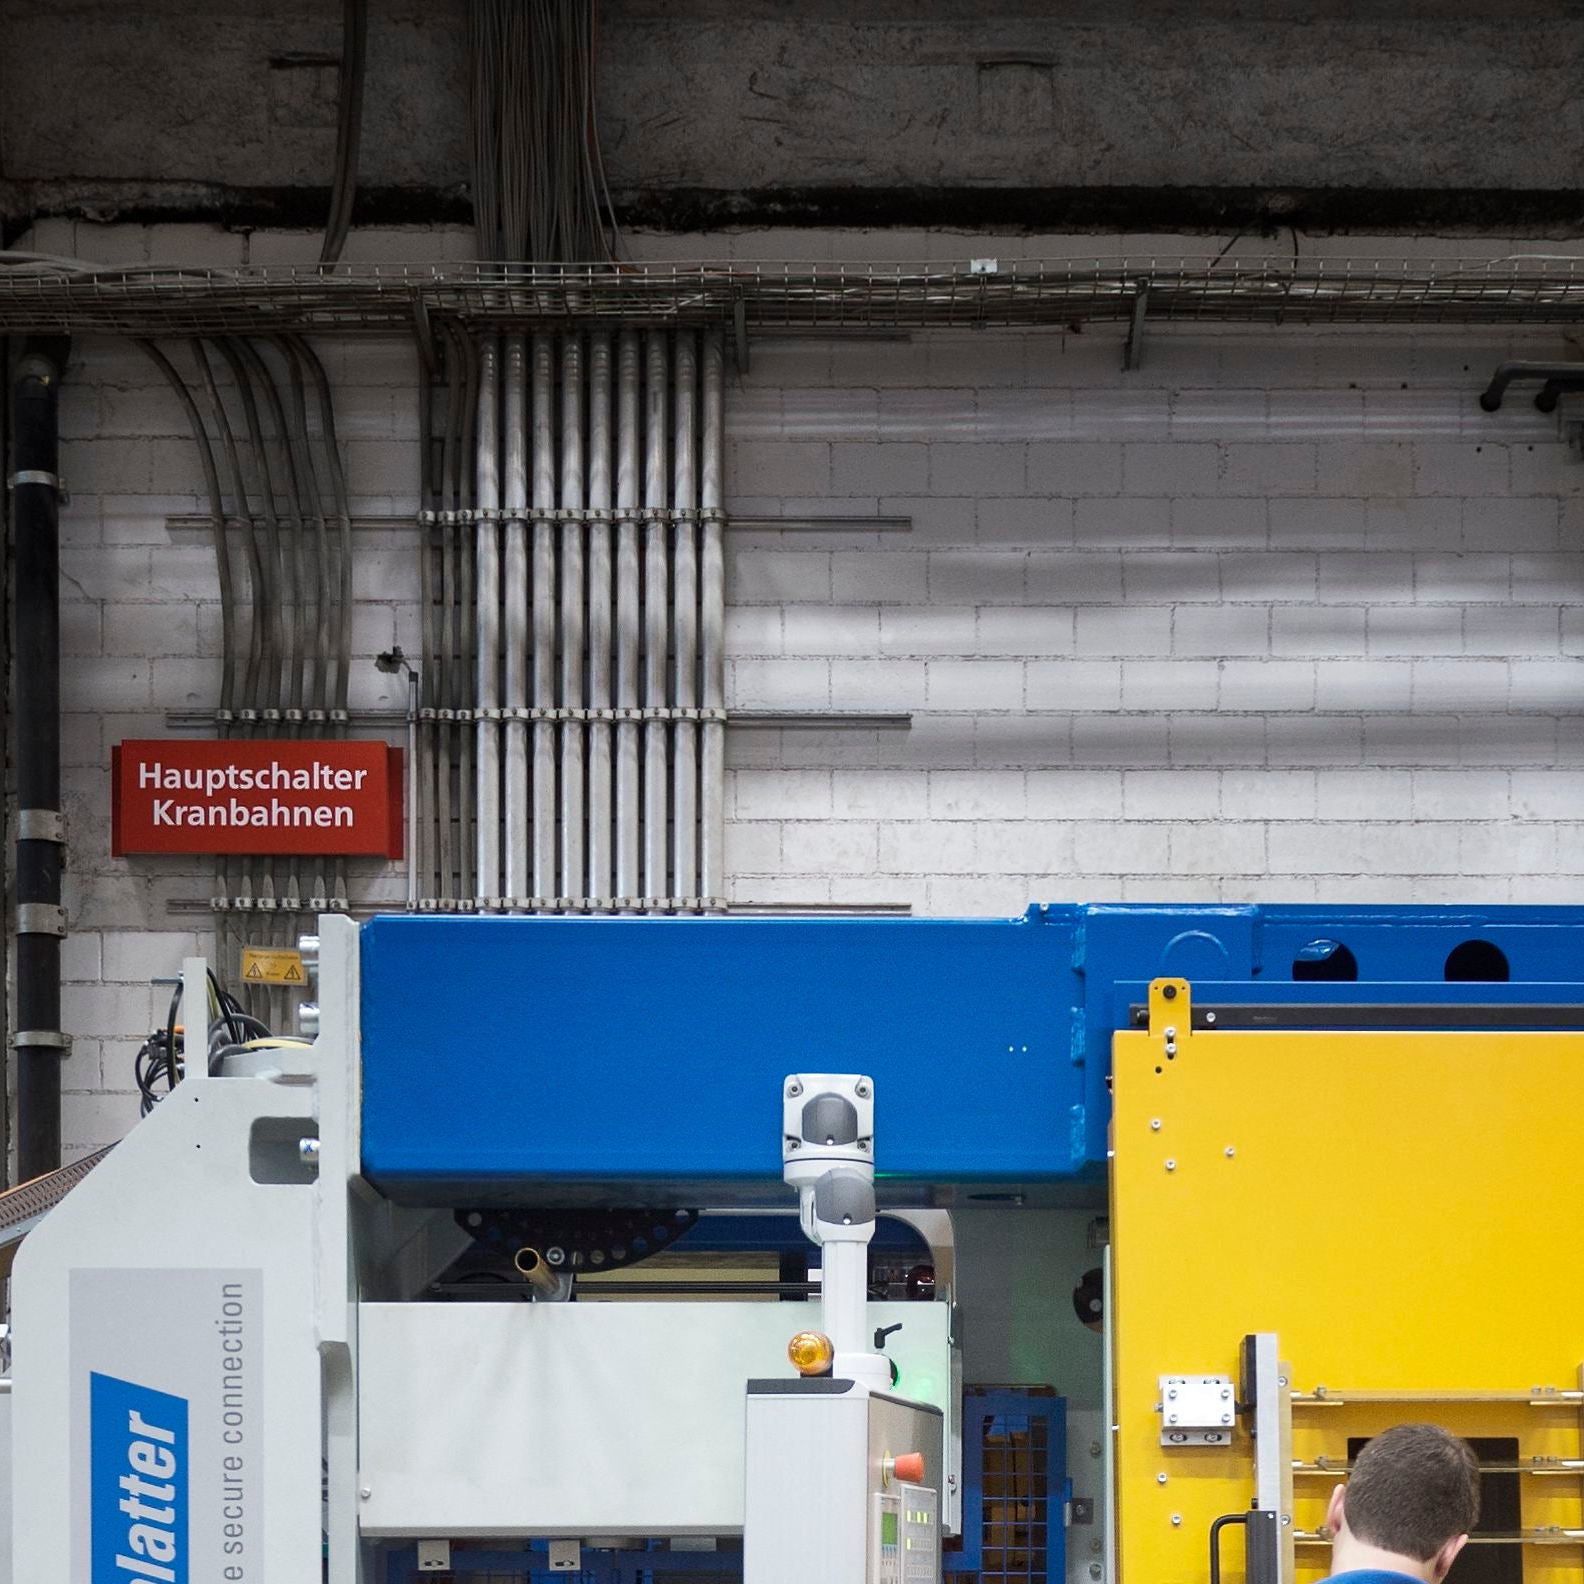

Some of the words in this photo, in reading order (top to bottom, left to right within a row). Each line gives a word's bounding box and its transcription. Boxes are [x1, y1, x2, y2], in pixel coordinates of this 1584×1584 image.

[139, 762, 368, 797] Hauptschalter
[153, 799, 354, 827] Kranbahnen
[215, 1284, 243, 1444] connection
[223, 1456, 244, 1554] secure
